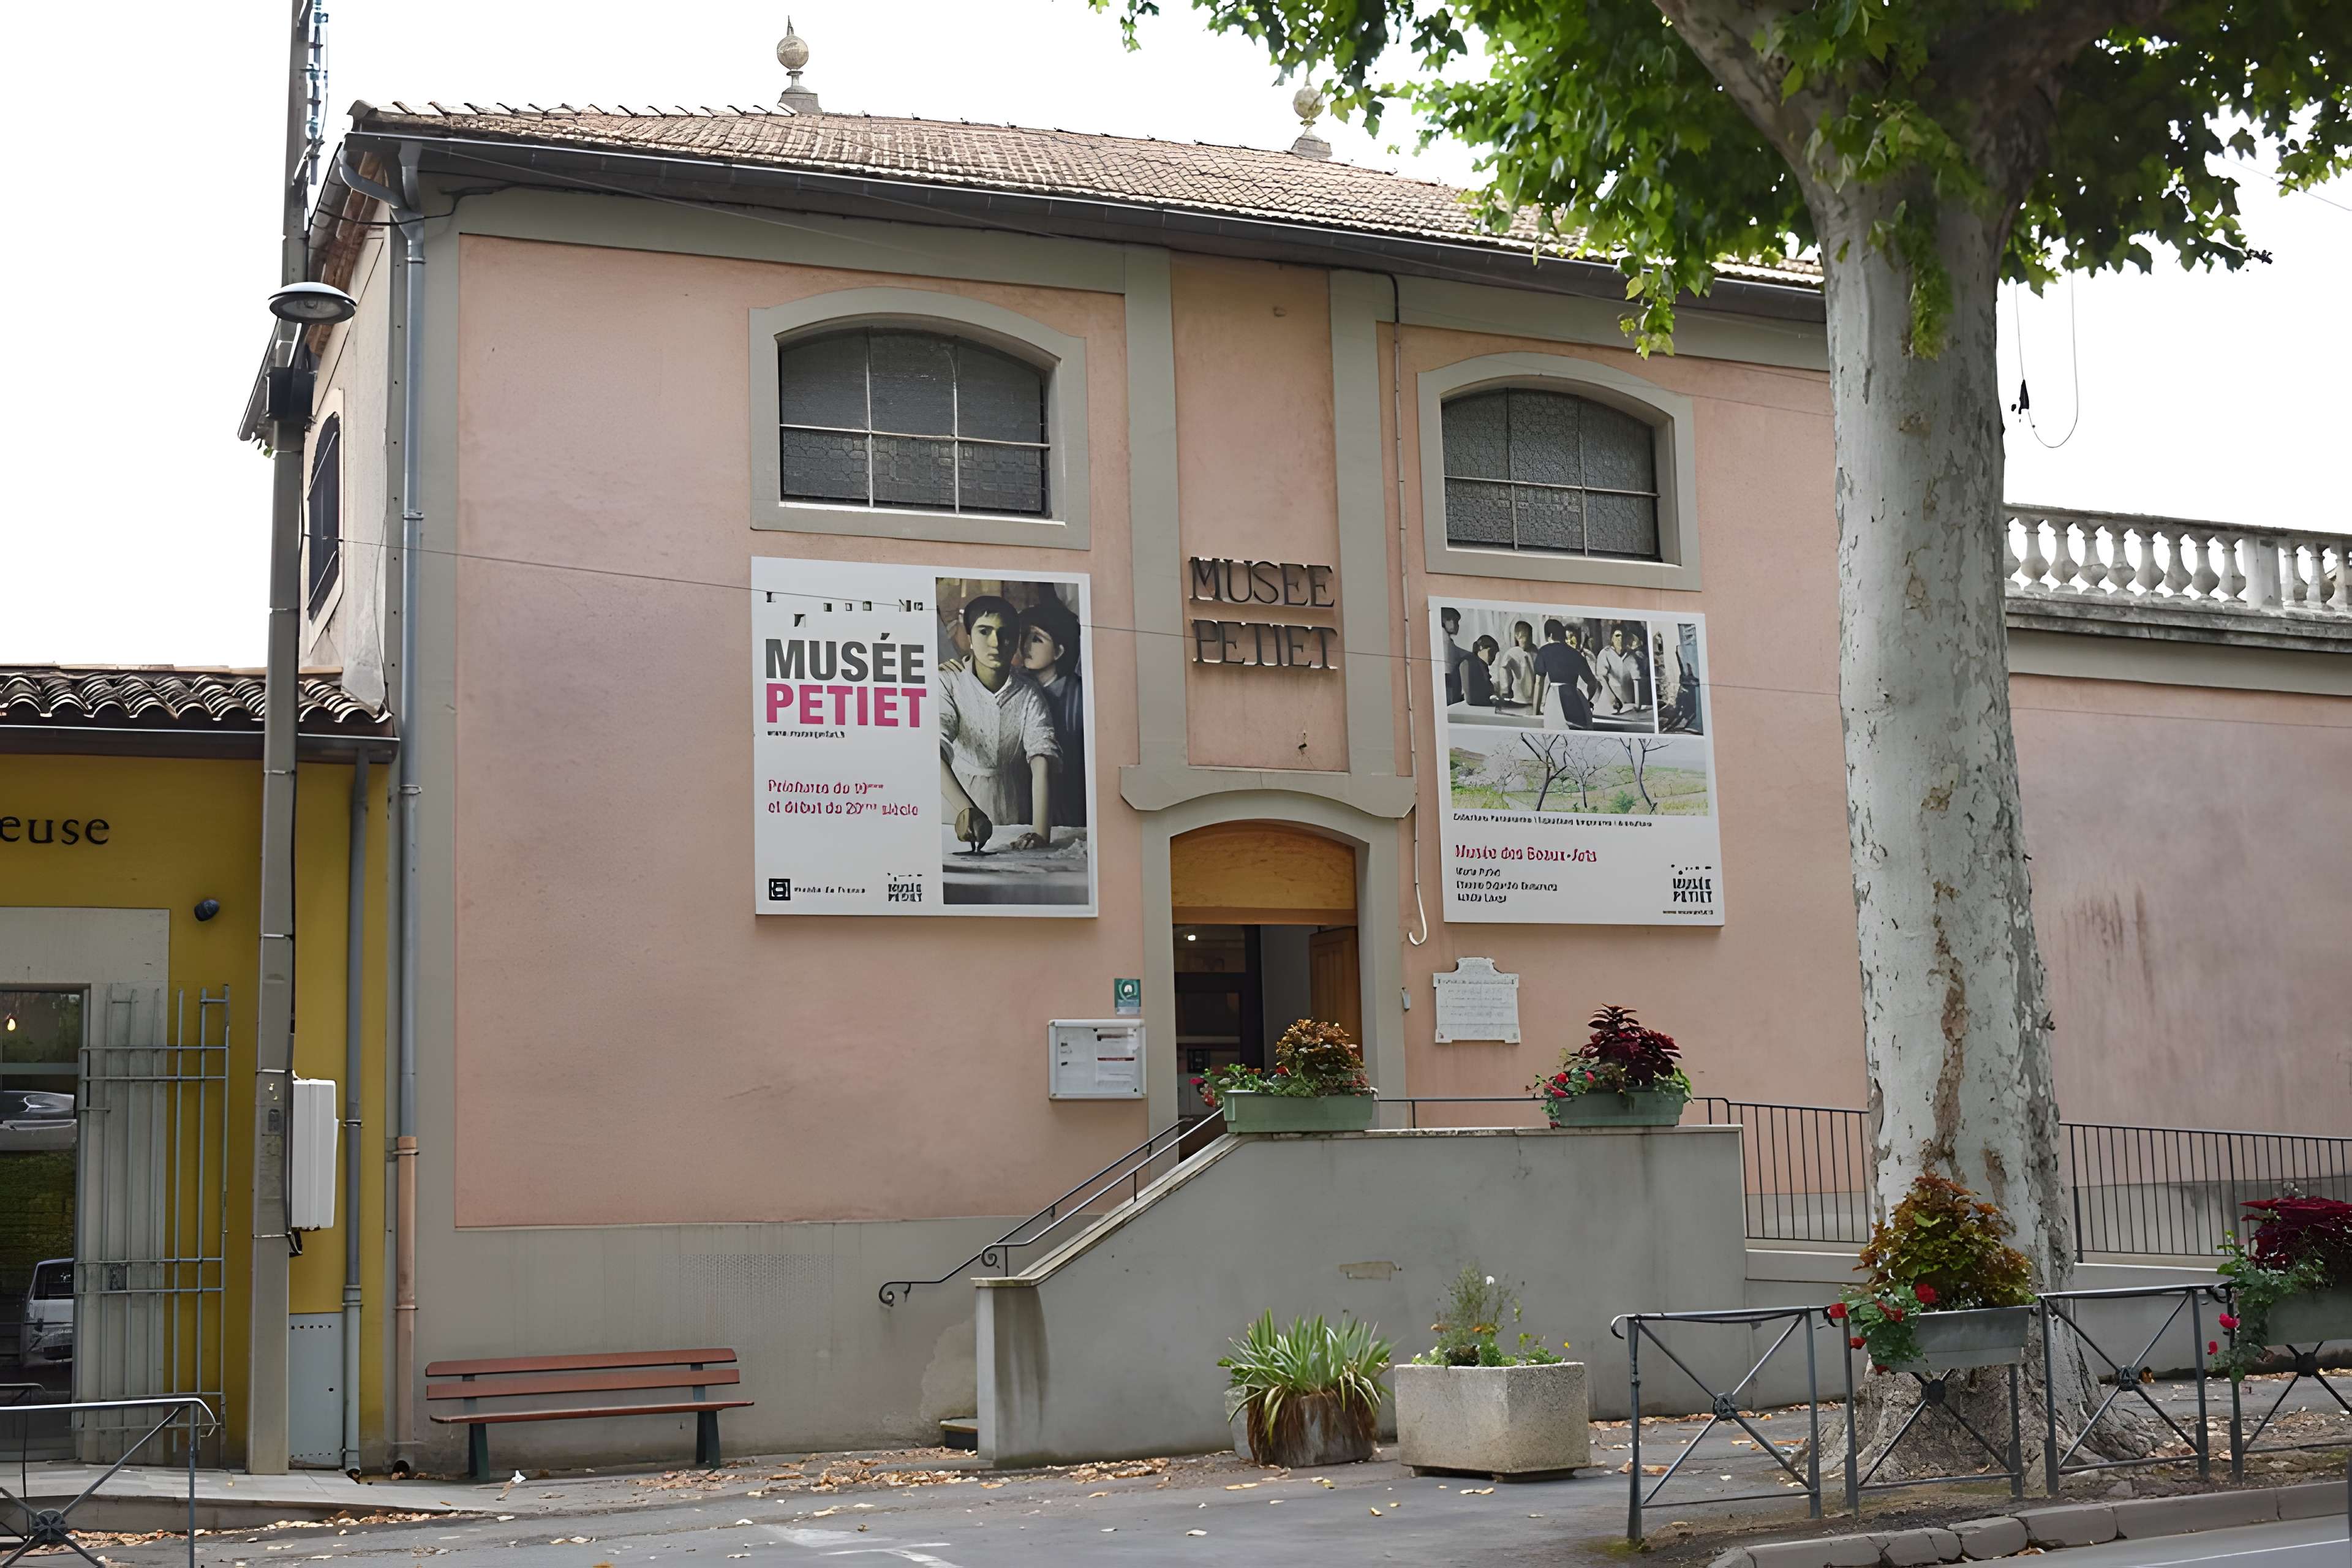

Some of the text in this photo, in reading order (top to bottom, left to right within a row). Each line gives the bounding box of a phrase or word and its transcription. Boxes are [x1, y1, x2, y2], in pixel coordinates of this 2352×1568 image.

[766, 632, 925, 684] MUSÉE
[1192, 619, 1338, 669] PETIET
[766, 683, 927, 728] PETIET
